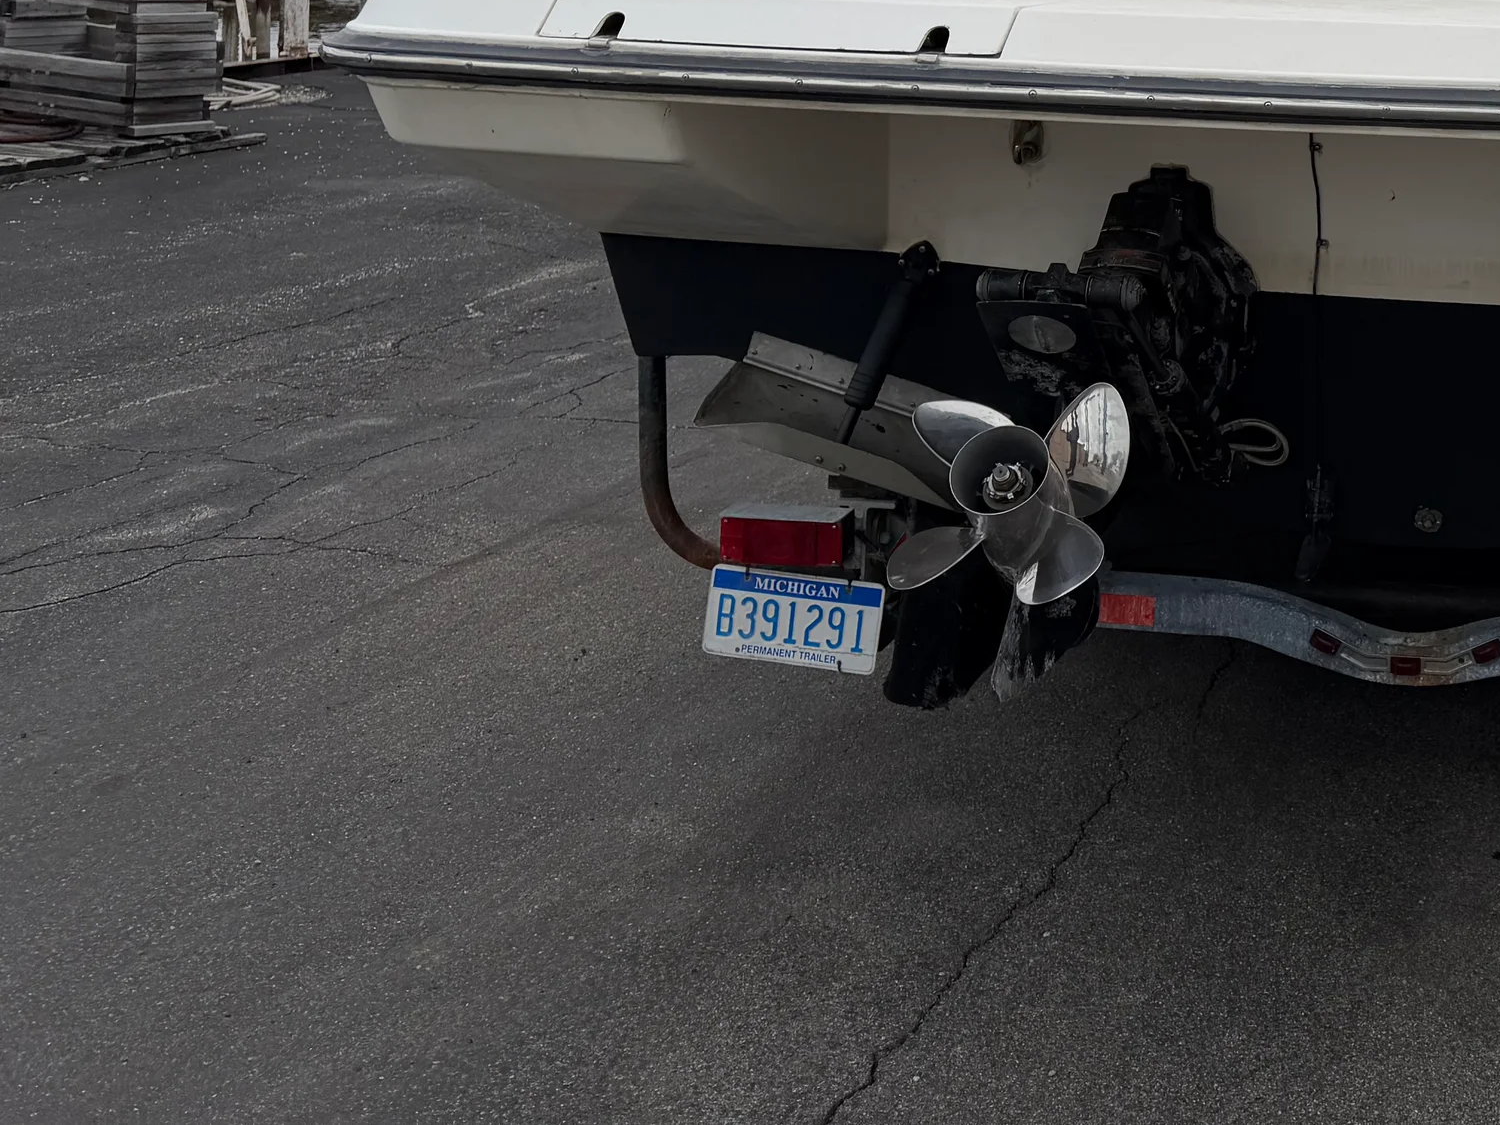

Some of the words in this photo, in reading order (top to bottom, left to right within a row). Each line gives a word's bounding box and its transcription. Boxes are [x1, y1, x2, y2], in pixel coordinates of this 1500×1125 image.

[754, 576, 840, 599] MICHIGAN
[715, 593, 864, 653] B391291
[741, 644, 797, 658] PERMANENT
[799, 651, 836, 664] TRAILER
